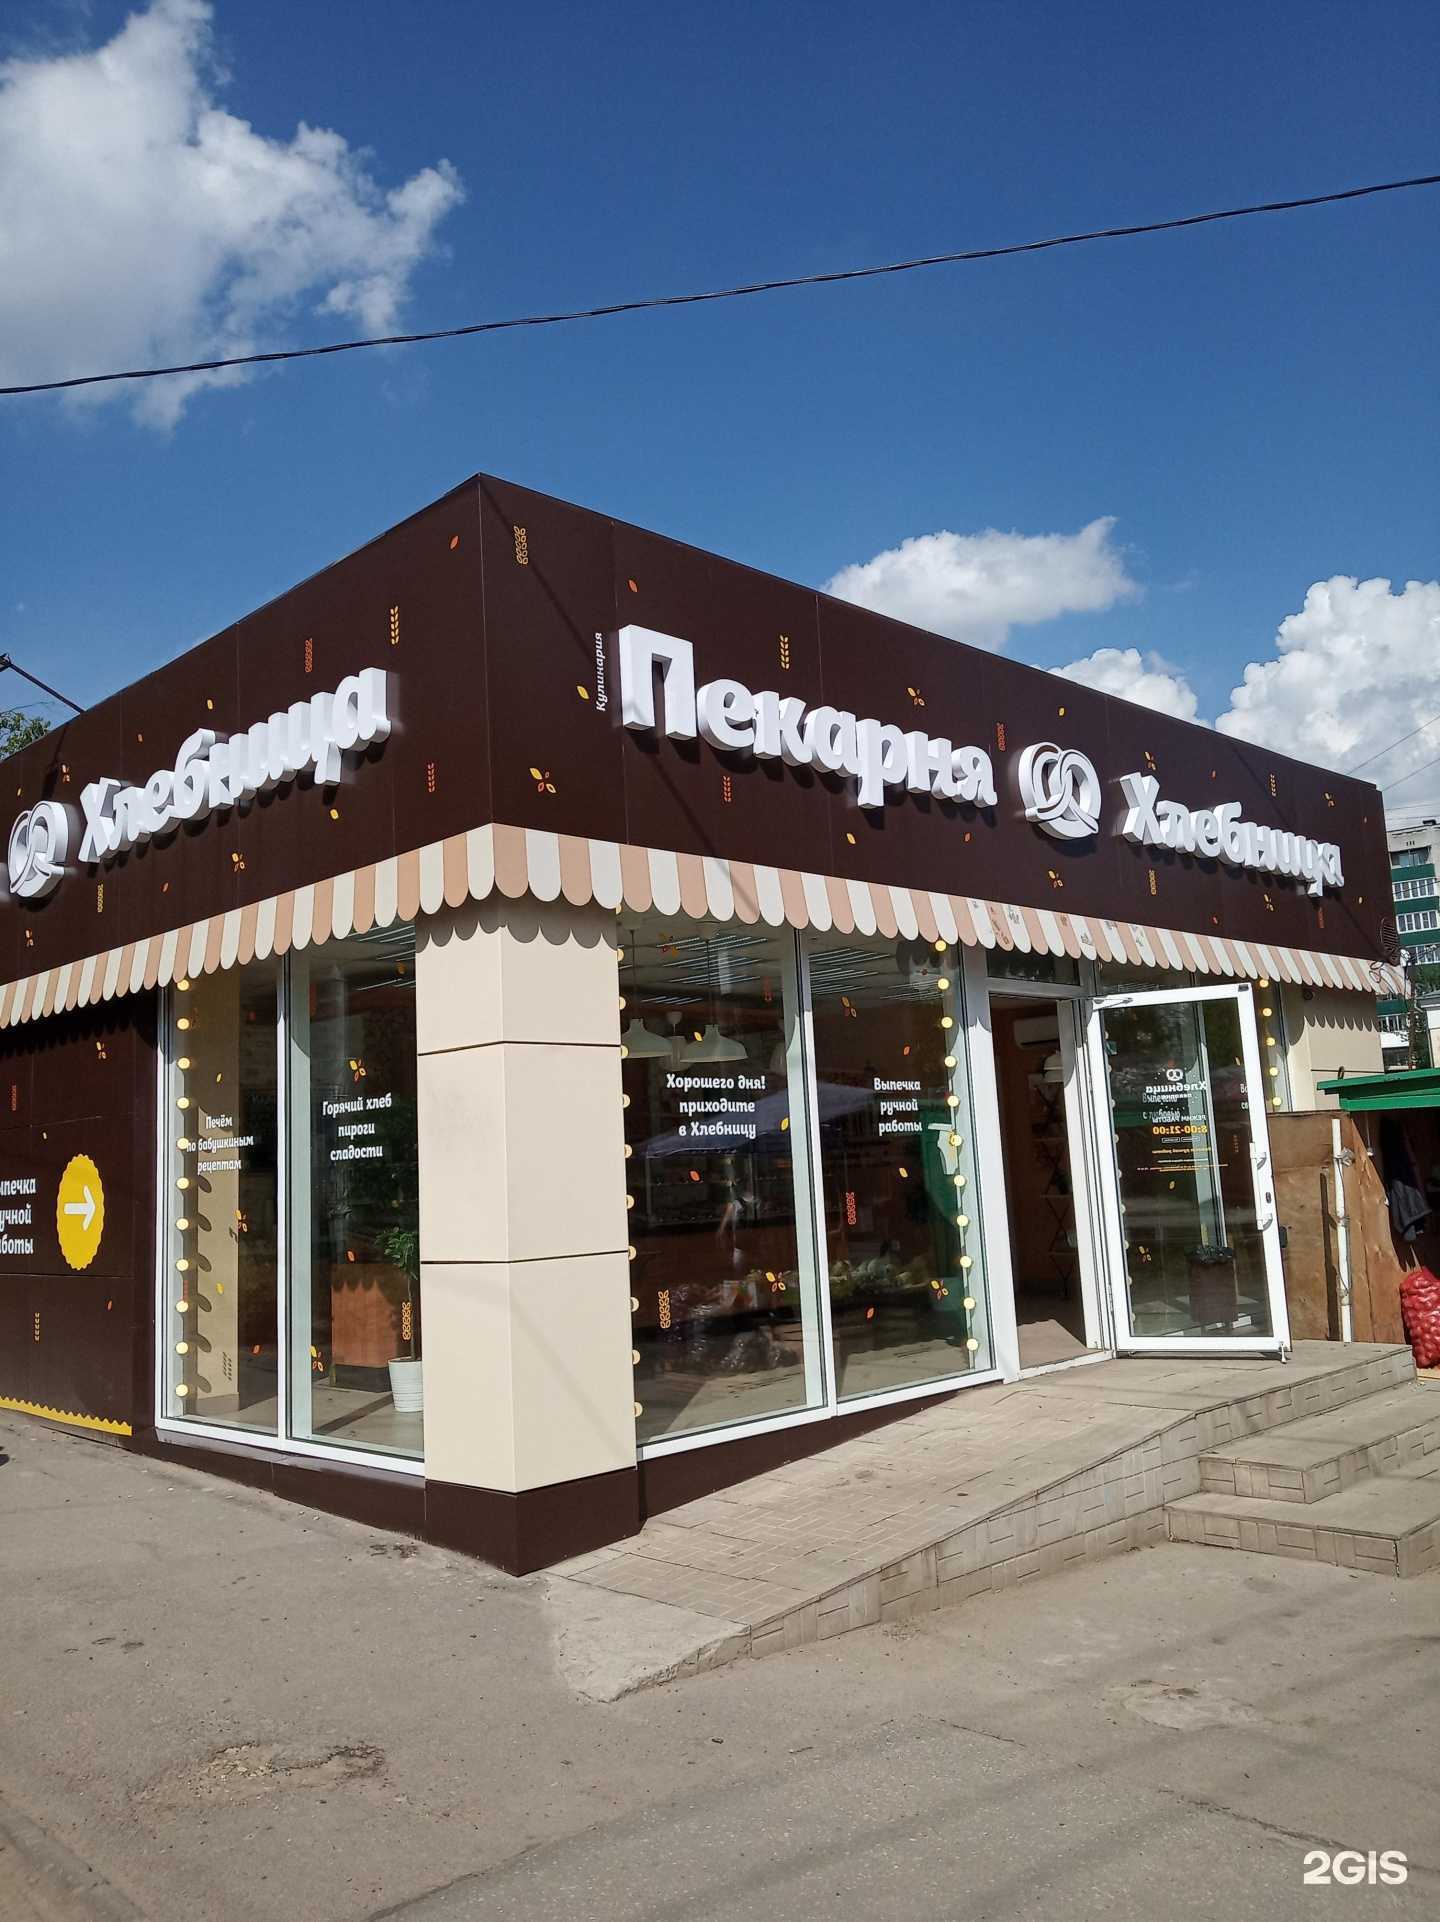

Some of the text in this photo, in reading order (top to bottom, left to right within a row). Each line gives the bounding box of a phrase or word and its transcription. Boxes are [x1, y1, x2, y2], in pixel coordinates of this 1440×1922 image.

[595, 632, 608, 712] Кулинария
[78, 667, 391, 862] Хлебница
[618, 624, 1344, 897] Пекарня Хлебница
[666, 1073, 766, 1093] Хорошего дня!
[873, 1077, 921, 1091] Выпечка
[322, 1092, 392, 1118] Горячий хлеб
[679, 1098, 756, 1116] приходите
[879, 1099, 919, 1116] ручной
[205, 1114, 233, 1129] Печём
[678, 1121, 757, 1138] в Хлебницу
[878, 1120, 923, 1136] работы
[337, 1123, 375, 1140] пироги
[186, 1135, 254, 1153] по бабушкиным
[330, 1144, 384, 1160] сладости
[197, 1160, 242, 1176] рецептам
[0, 1234, 33, 1254] боты
